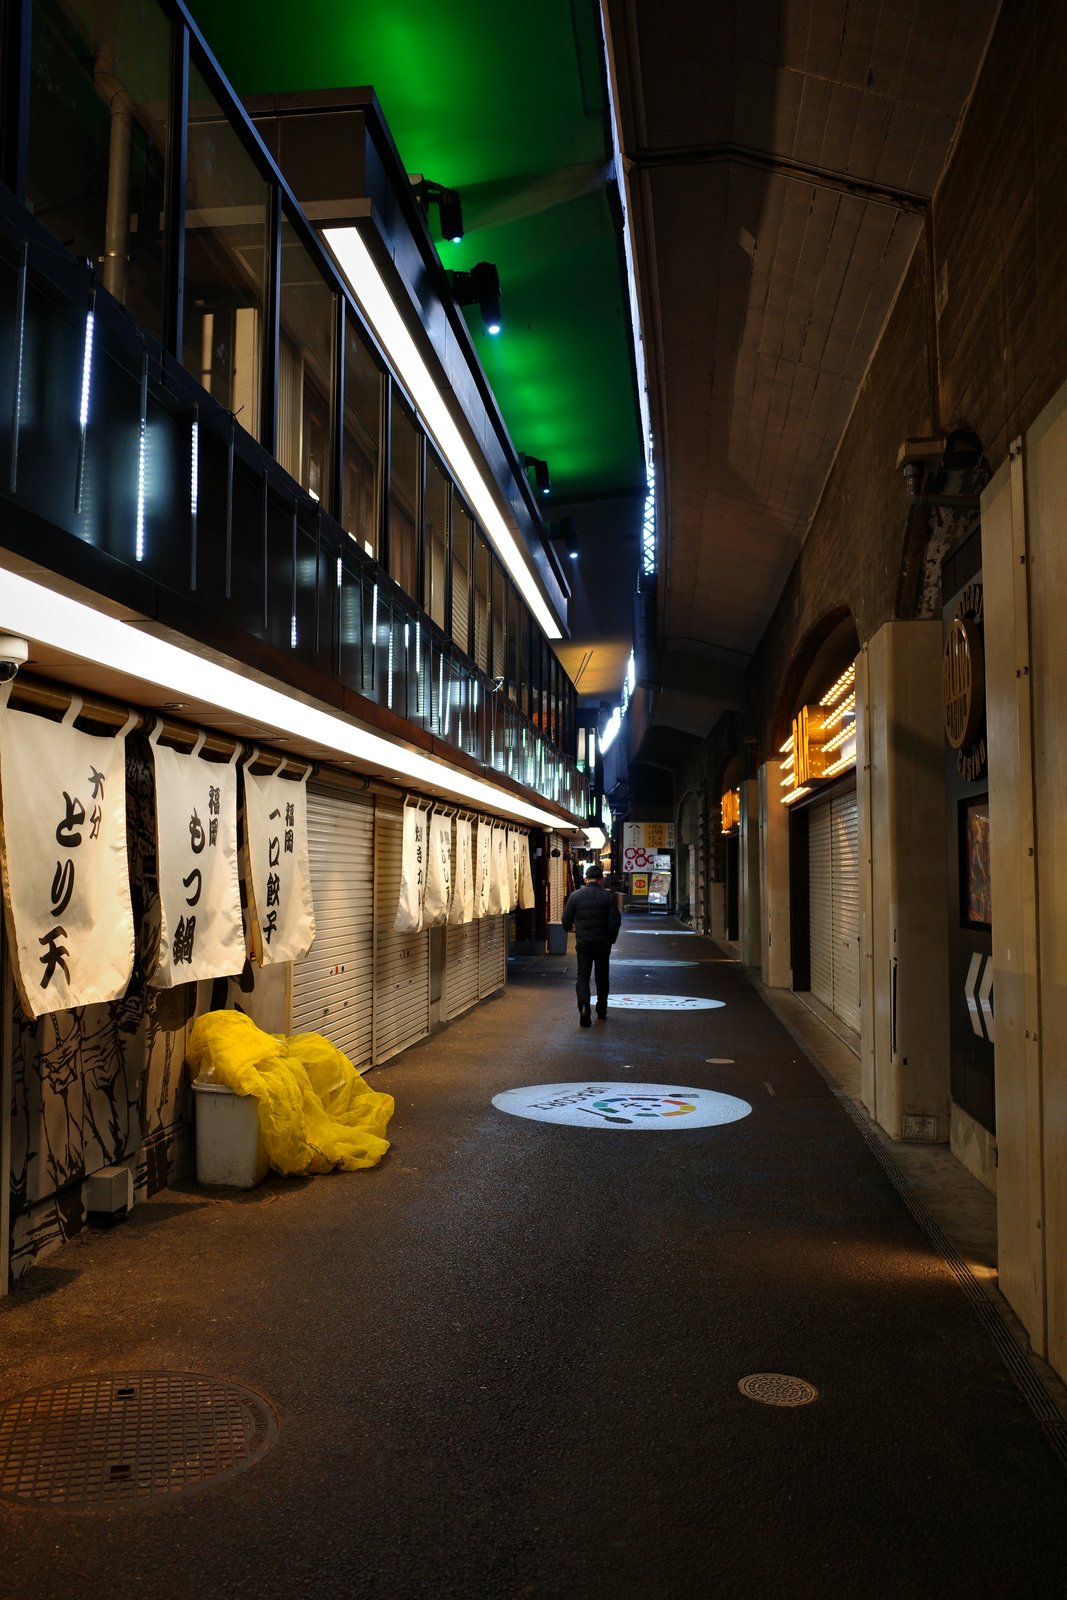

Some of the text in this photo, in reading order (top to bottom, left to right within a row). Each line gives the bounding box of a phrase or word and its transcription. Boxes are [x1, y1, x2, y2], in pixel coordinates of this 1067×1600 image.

[956, 738, 986, 782] CASINO
[87, 764, 106, 841] 大分
[208, 785, 221, 847] 福岡
[284, 801, 296, 854] 福岡
[38, 790, 86, 990] とり天
[172, 807, 206, 967] もつ鍋
[262, 807, 282, 945] 一口餃子
